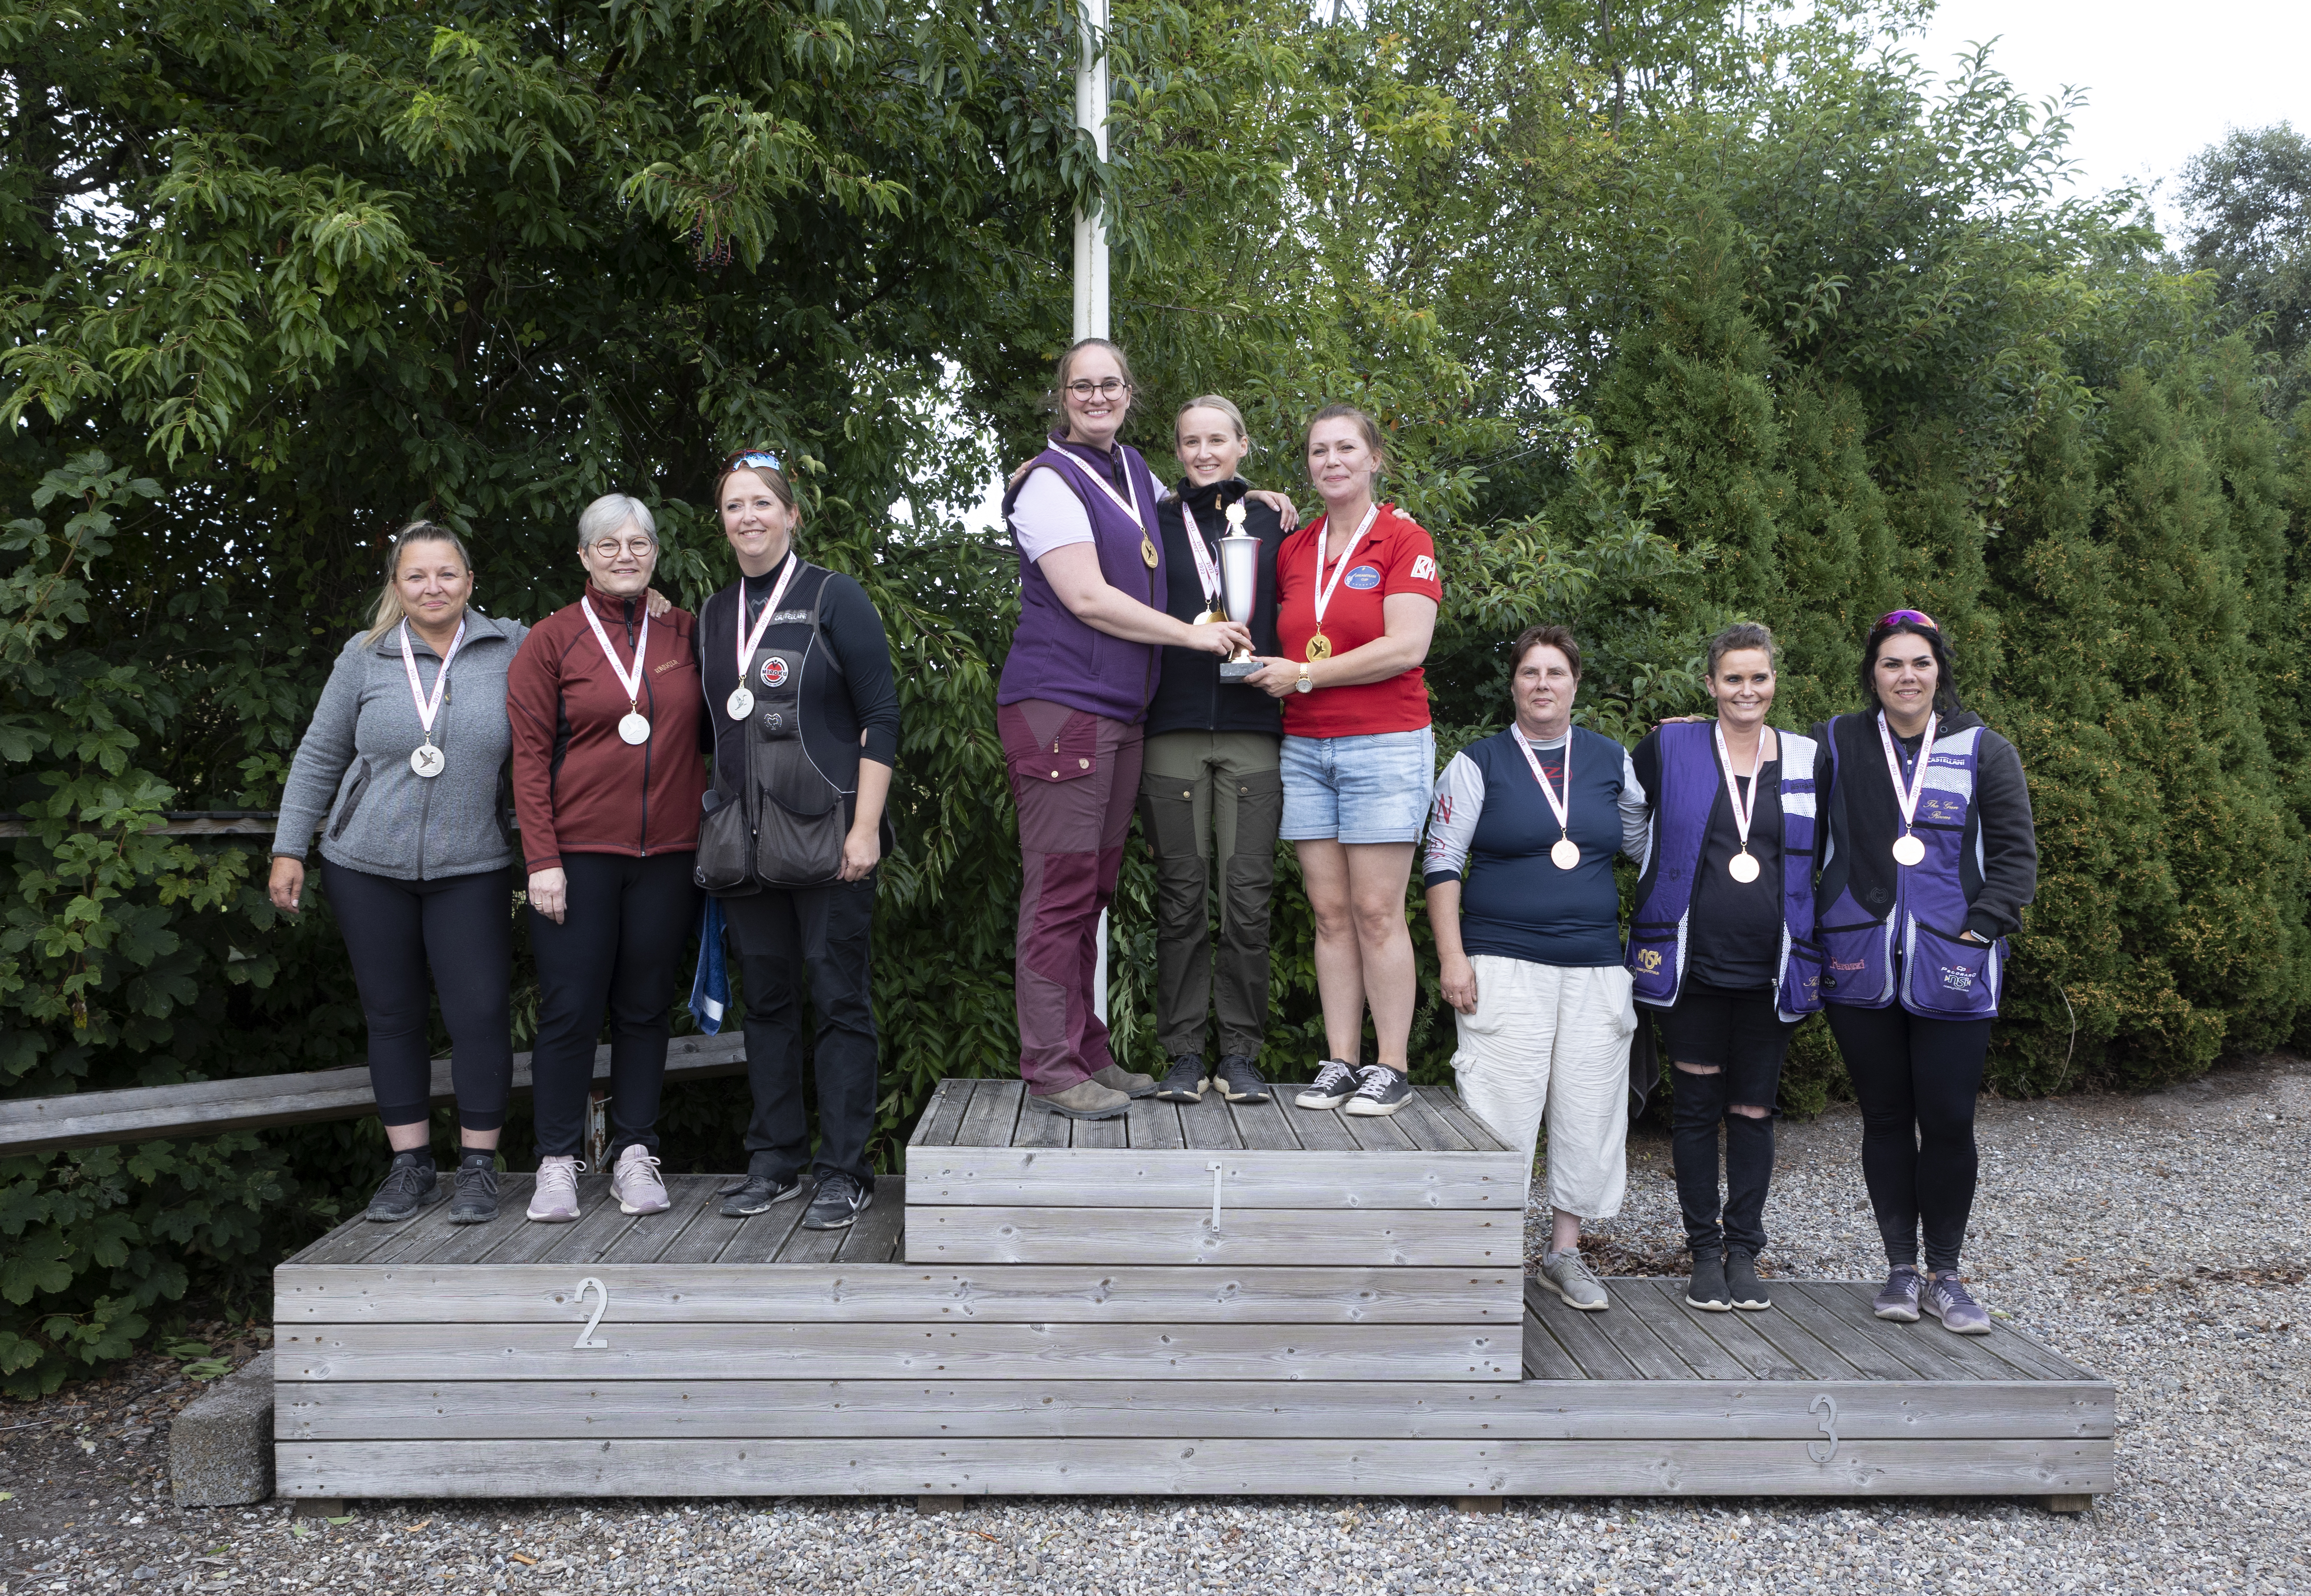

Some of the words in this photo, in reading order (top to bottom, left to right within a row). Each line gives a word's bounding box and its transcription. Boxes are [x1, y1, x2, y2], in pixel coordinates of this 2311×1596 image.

[1077, 460, 1089, 471] 2022
[1095, 478, 1107, 489] 2022
[1114, 496, 1125, 507] 2022
[1326, 585, 1334, 596] 2022
[1336, 563, 1344, 575] 2022
[1357, 524, 1366, 535] 2022
[750, 638, 758, 651] 2022
[760, 616, 769, 628] 2022
[770, 595, 779, 607] 2022
[780, 573, 789, 586] 2022
[594, 623, 603, 634] 2022
[604, 643, 613, 655] 2022
[615, 664, 625, 675] 2022
[432, 691, 441, 704] 2022
[1923, 799, 1939, 808] The
[1944, 801, 1959, 810] Gun
[1928, 811, 1951, 820] Room
[1830, 956, 1864, 970] Perazzi
[1205, 1162, 1222, 1232] 1
[573, 1277, 608, 1349] 2
[1807, 1394, 1838, 1463] 3
